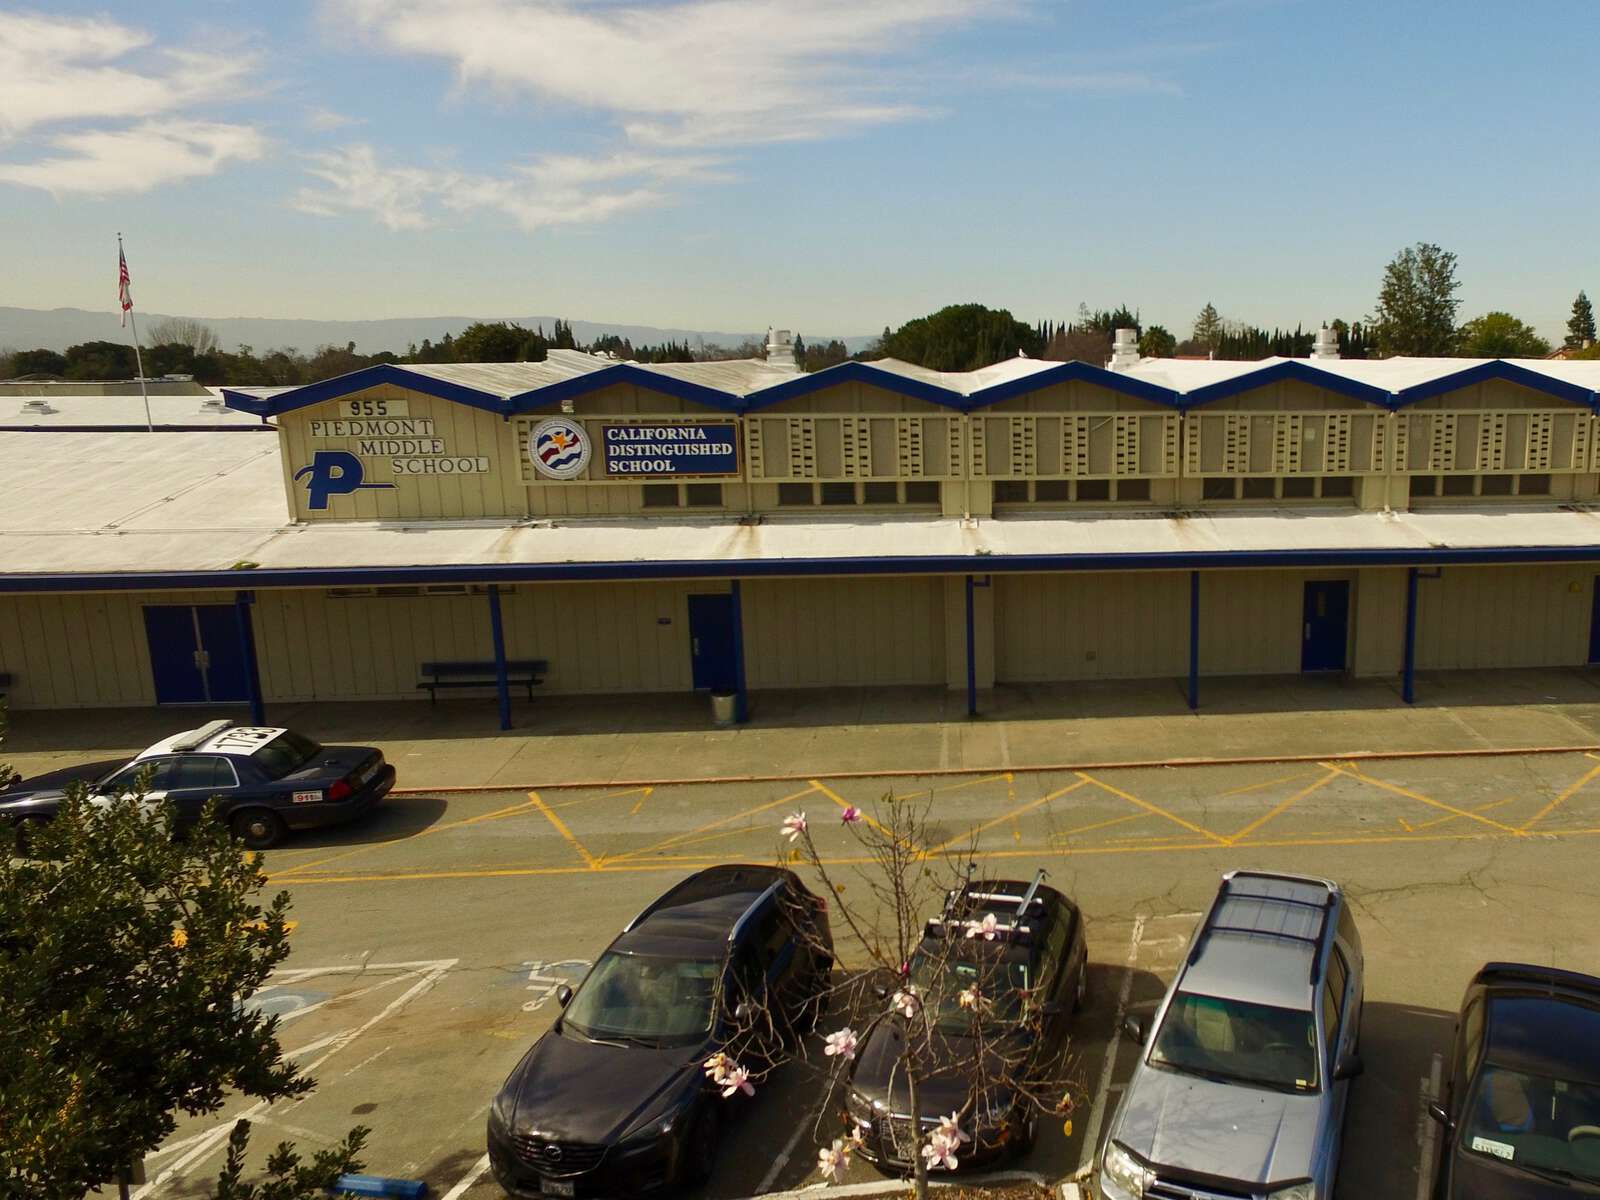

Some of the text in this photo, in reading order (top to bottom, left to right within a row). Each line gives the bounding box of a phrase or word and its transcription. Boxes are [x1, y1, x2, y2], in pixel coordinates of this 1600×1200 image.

[351, 400, 388, 416] 955
[310, 419, 432, 437] PIEDMONT
[607, 427, 707, 441] CALIFORNIA
[360, 439, 444, 456] MIDDLE
[609, 443, 733, 457] DISTINGUISHED
[392, 458, 488, 474] SCHOOL
[609, 460, 676, 473] SCHOOL
